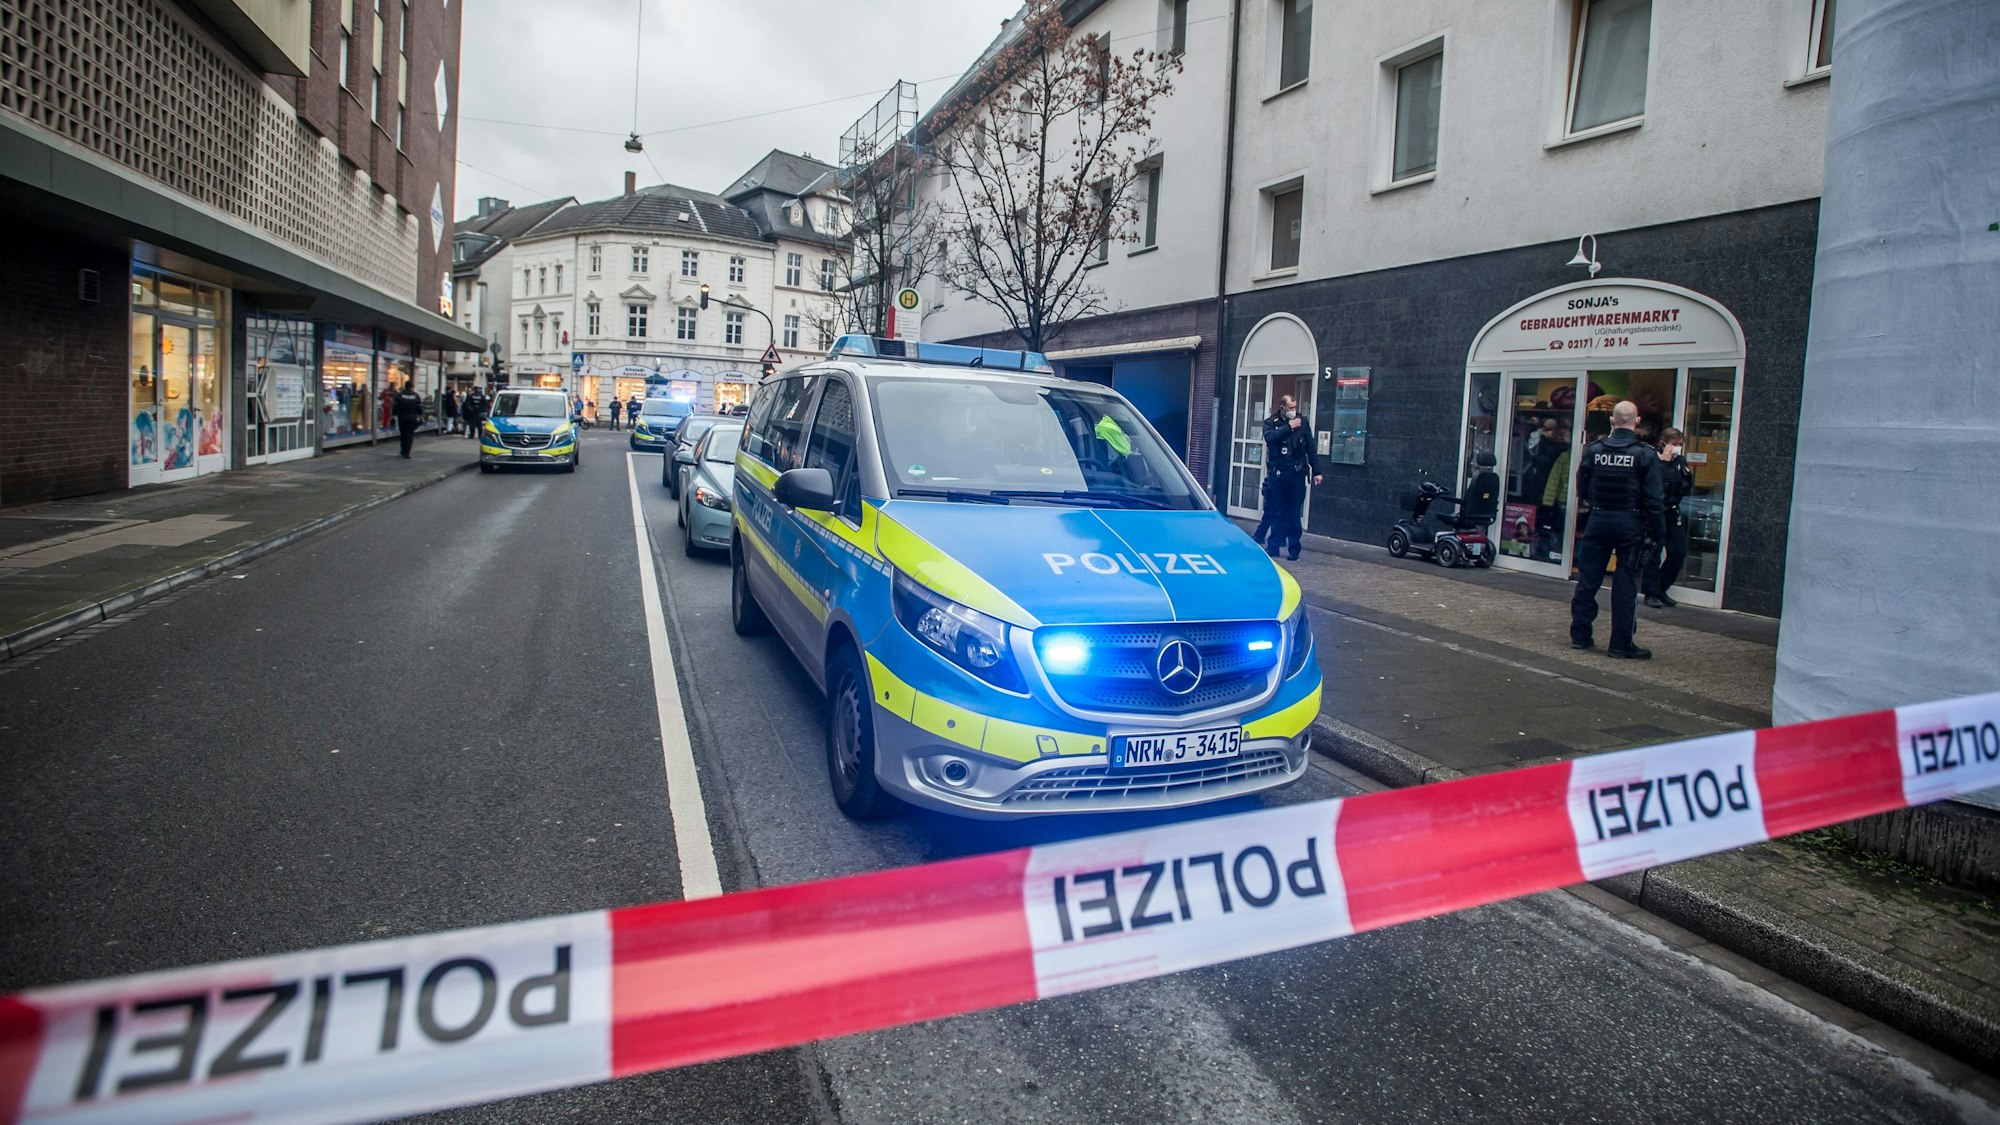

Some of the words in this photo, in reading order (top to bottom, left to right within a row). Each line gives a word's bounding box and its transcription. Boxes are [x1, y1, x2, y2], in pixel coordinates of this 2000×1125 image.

[904, 293, 913, 305] H
[1567, 296, 1619, 310] SONJA's
[1520, 309, 1680, 330] GEBRAUCHTWARENMARKT
[1594, 324, 1682, 336] UG(haftungsbeschränkt)
[1567, 338, 1593, 349] 02171
[1604, 338, 1615, 348] 20
[1618, 337, 1629, 347] 14
[1594, 453, 1635, 467] POLIZEI
[752, 494, 773, 534] POLIZEI
[1042, 553, 1228, 575] POLIZEI
[1126, 739, 1165, 763] NRW
[1175, 731, 1239, 759] 5-3415
[1911, 721, 2000, 776] OLIZEI
[1589, 764, 1751, 840] POLIZEI
[1053, 837, 1326, 942] POLIZEI
[73, 944, 573, 1102] POLIZEI
